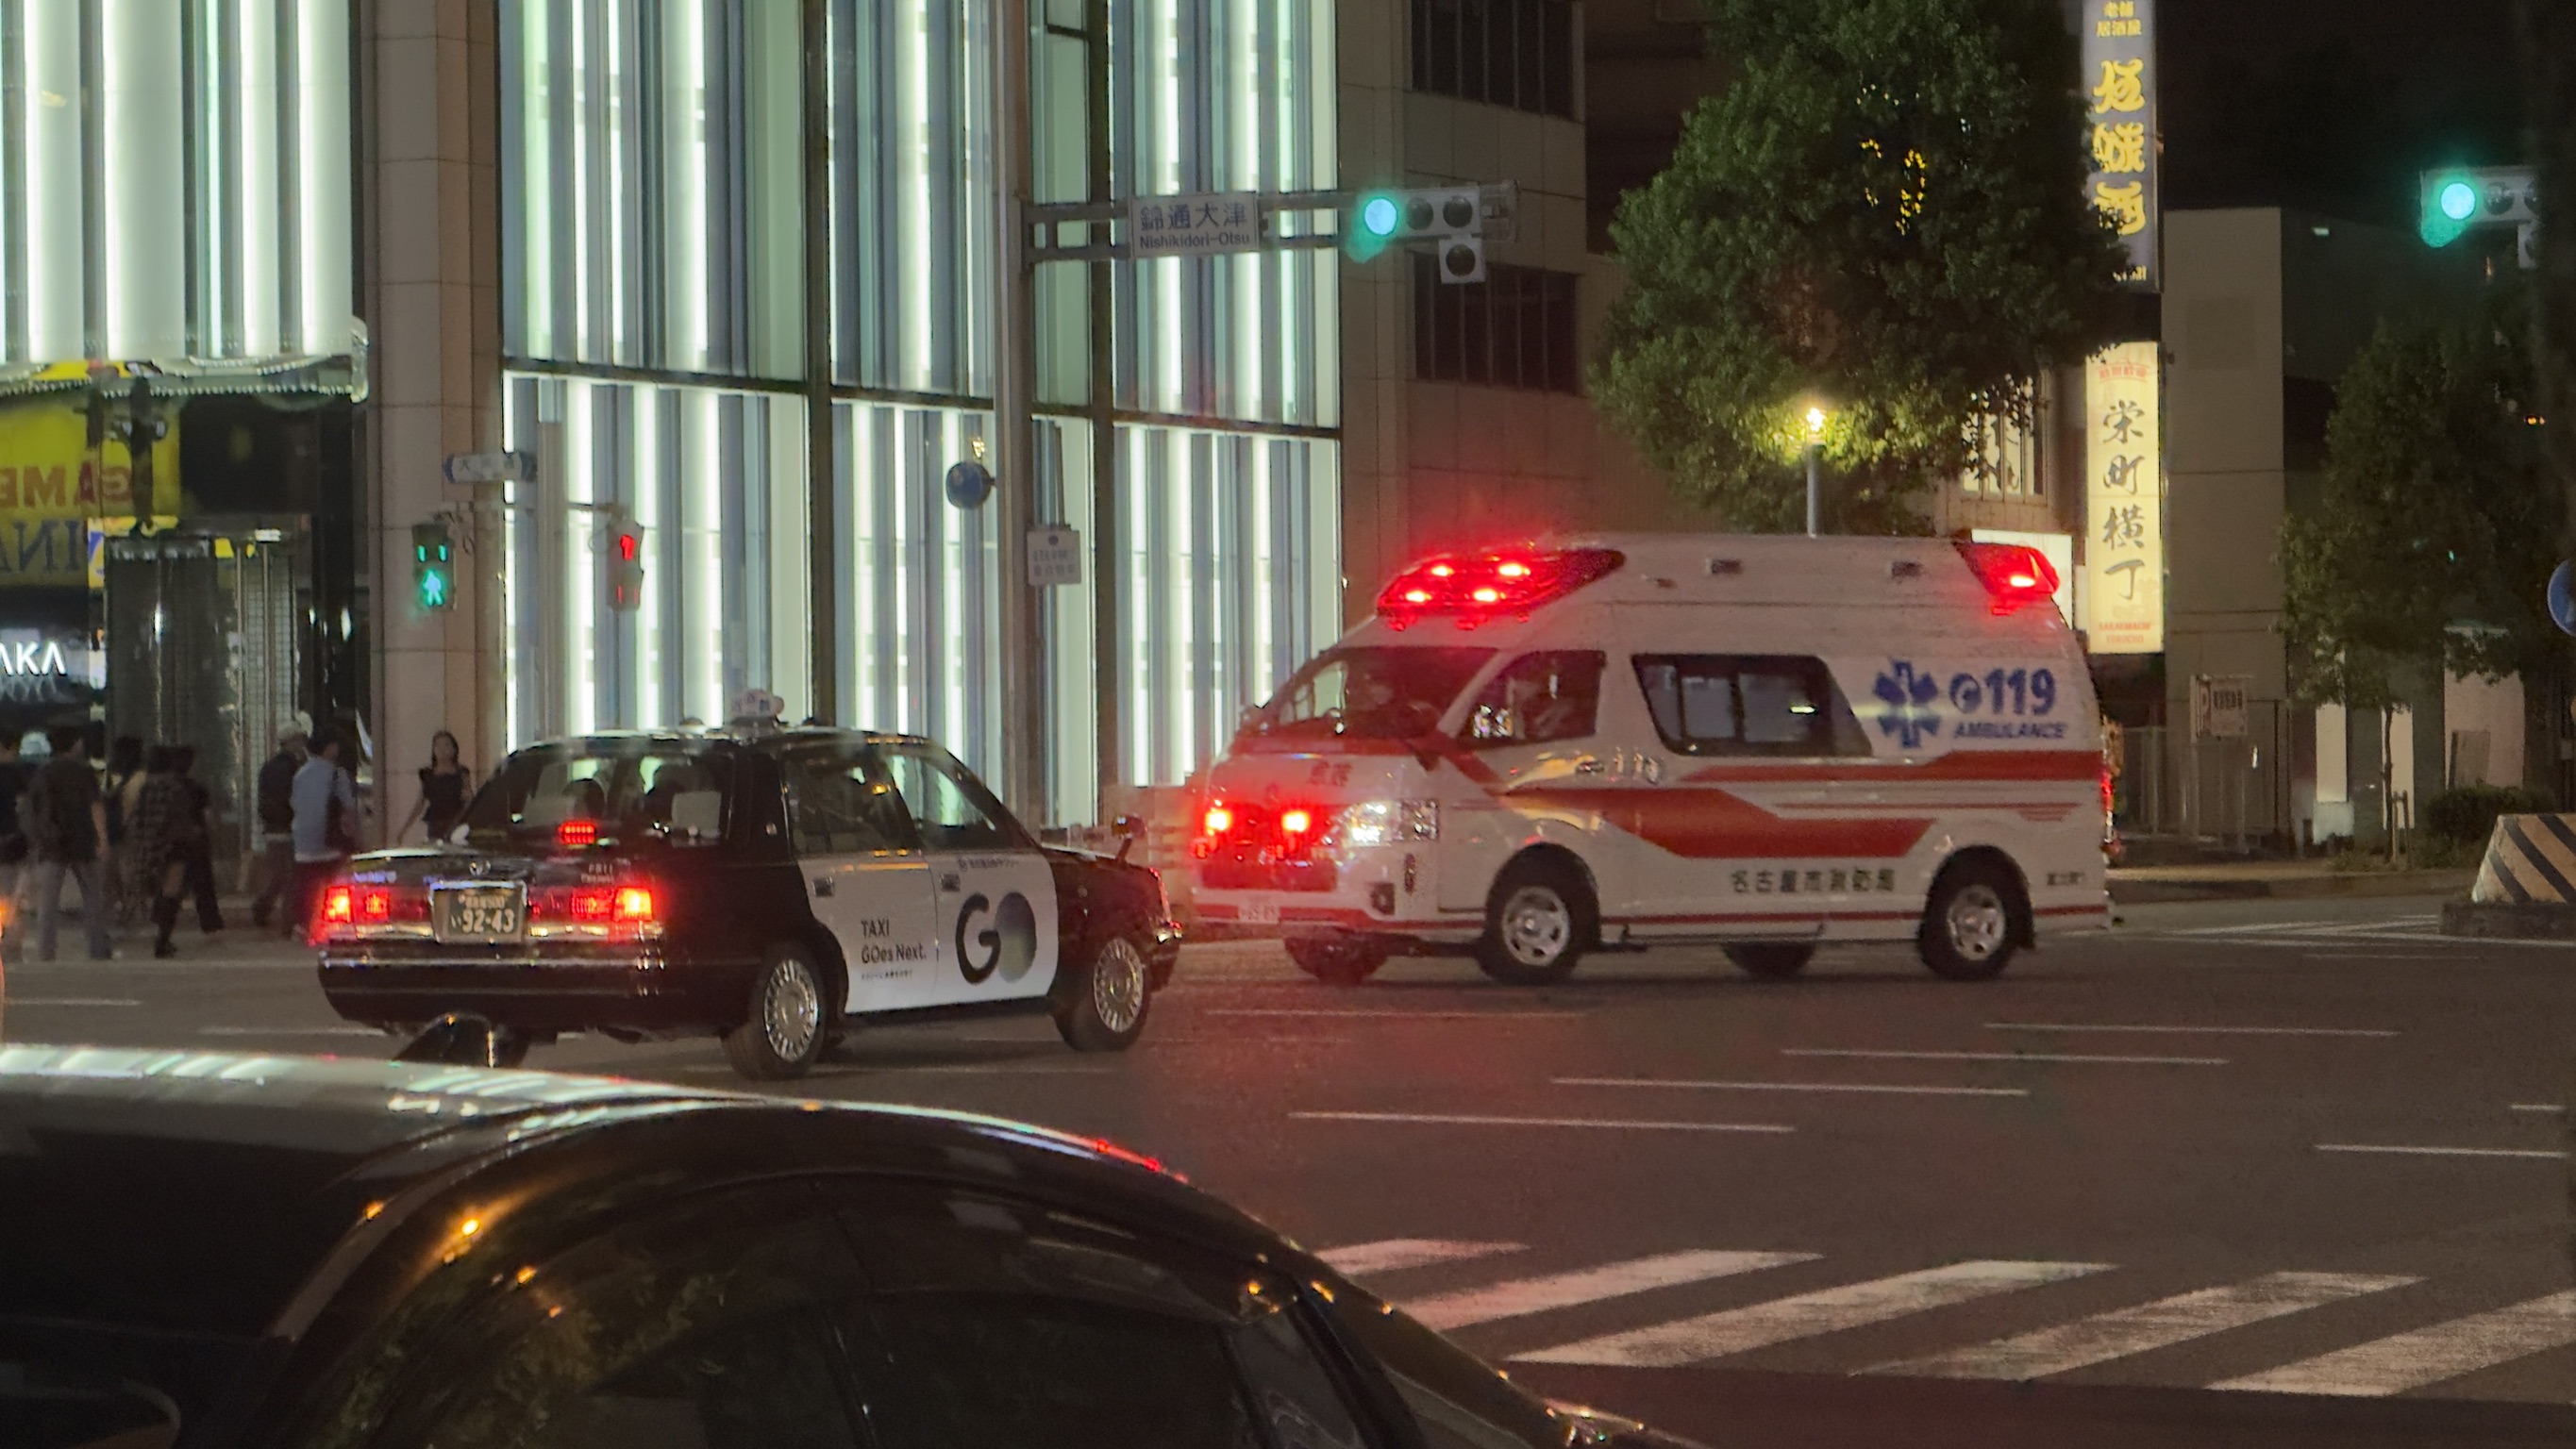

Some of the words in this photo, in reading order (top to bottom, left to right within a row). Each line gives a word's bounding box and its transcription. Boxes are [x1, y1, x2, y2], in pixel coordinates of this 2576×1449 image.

[1140, 201, 1247, 231] 錦通大津
[1140, 231, 1250, 249] Nishikidori-Otsu
[2102, 400, 2146, 601] 栄町横丁
[1984, 669, 2055, 714] 119
[1954, 722, 2065, 739] AMBULANCE
[861, 919, 890, 938] TAXI
[955, 891, 1037, 985] GO
[861, 944, 894, 964] GOes
[896, 944, 927, 962] Next.
